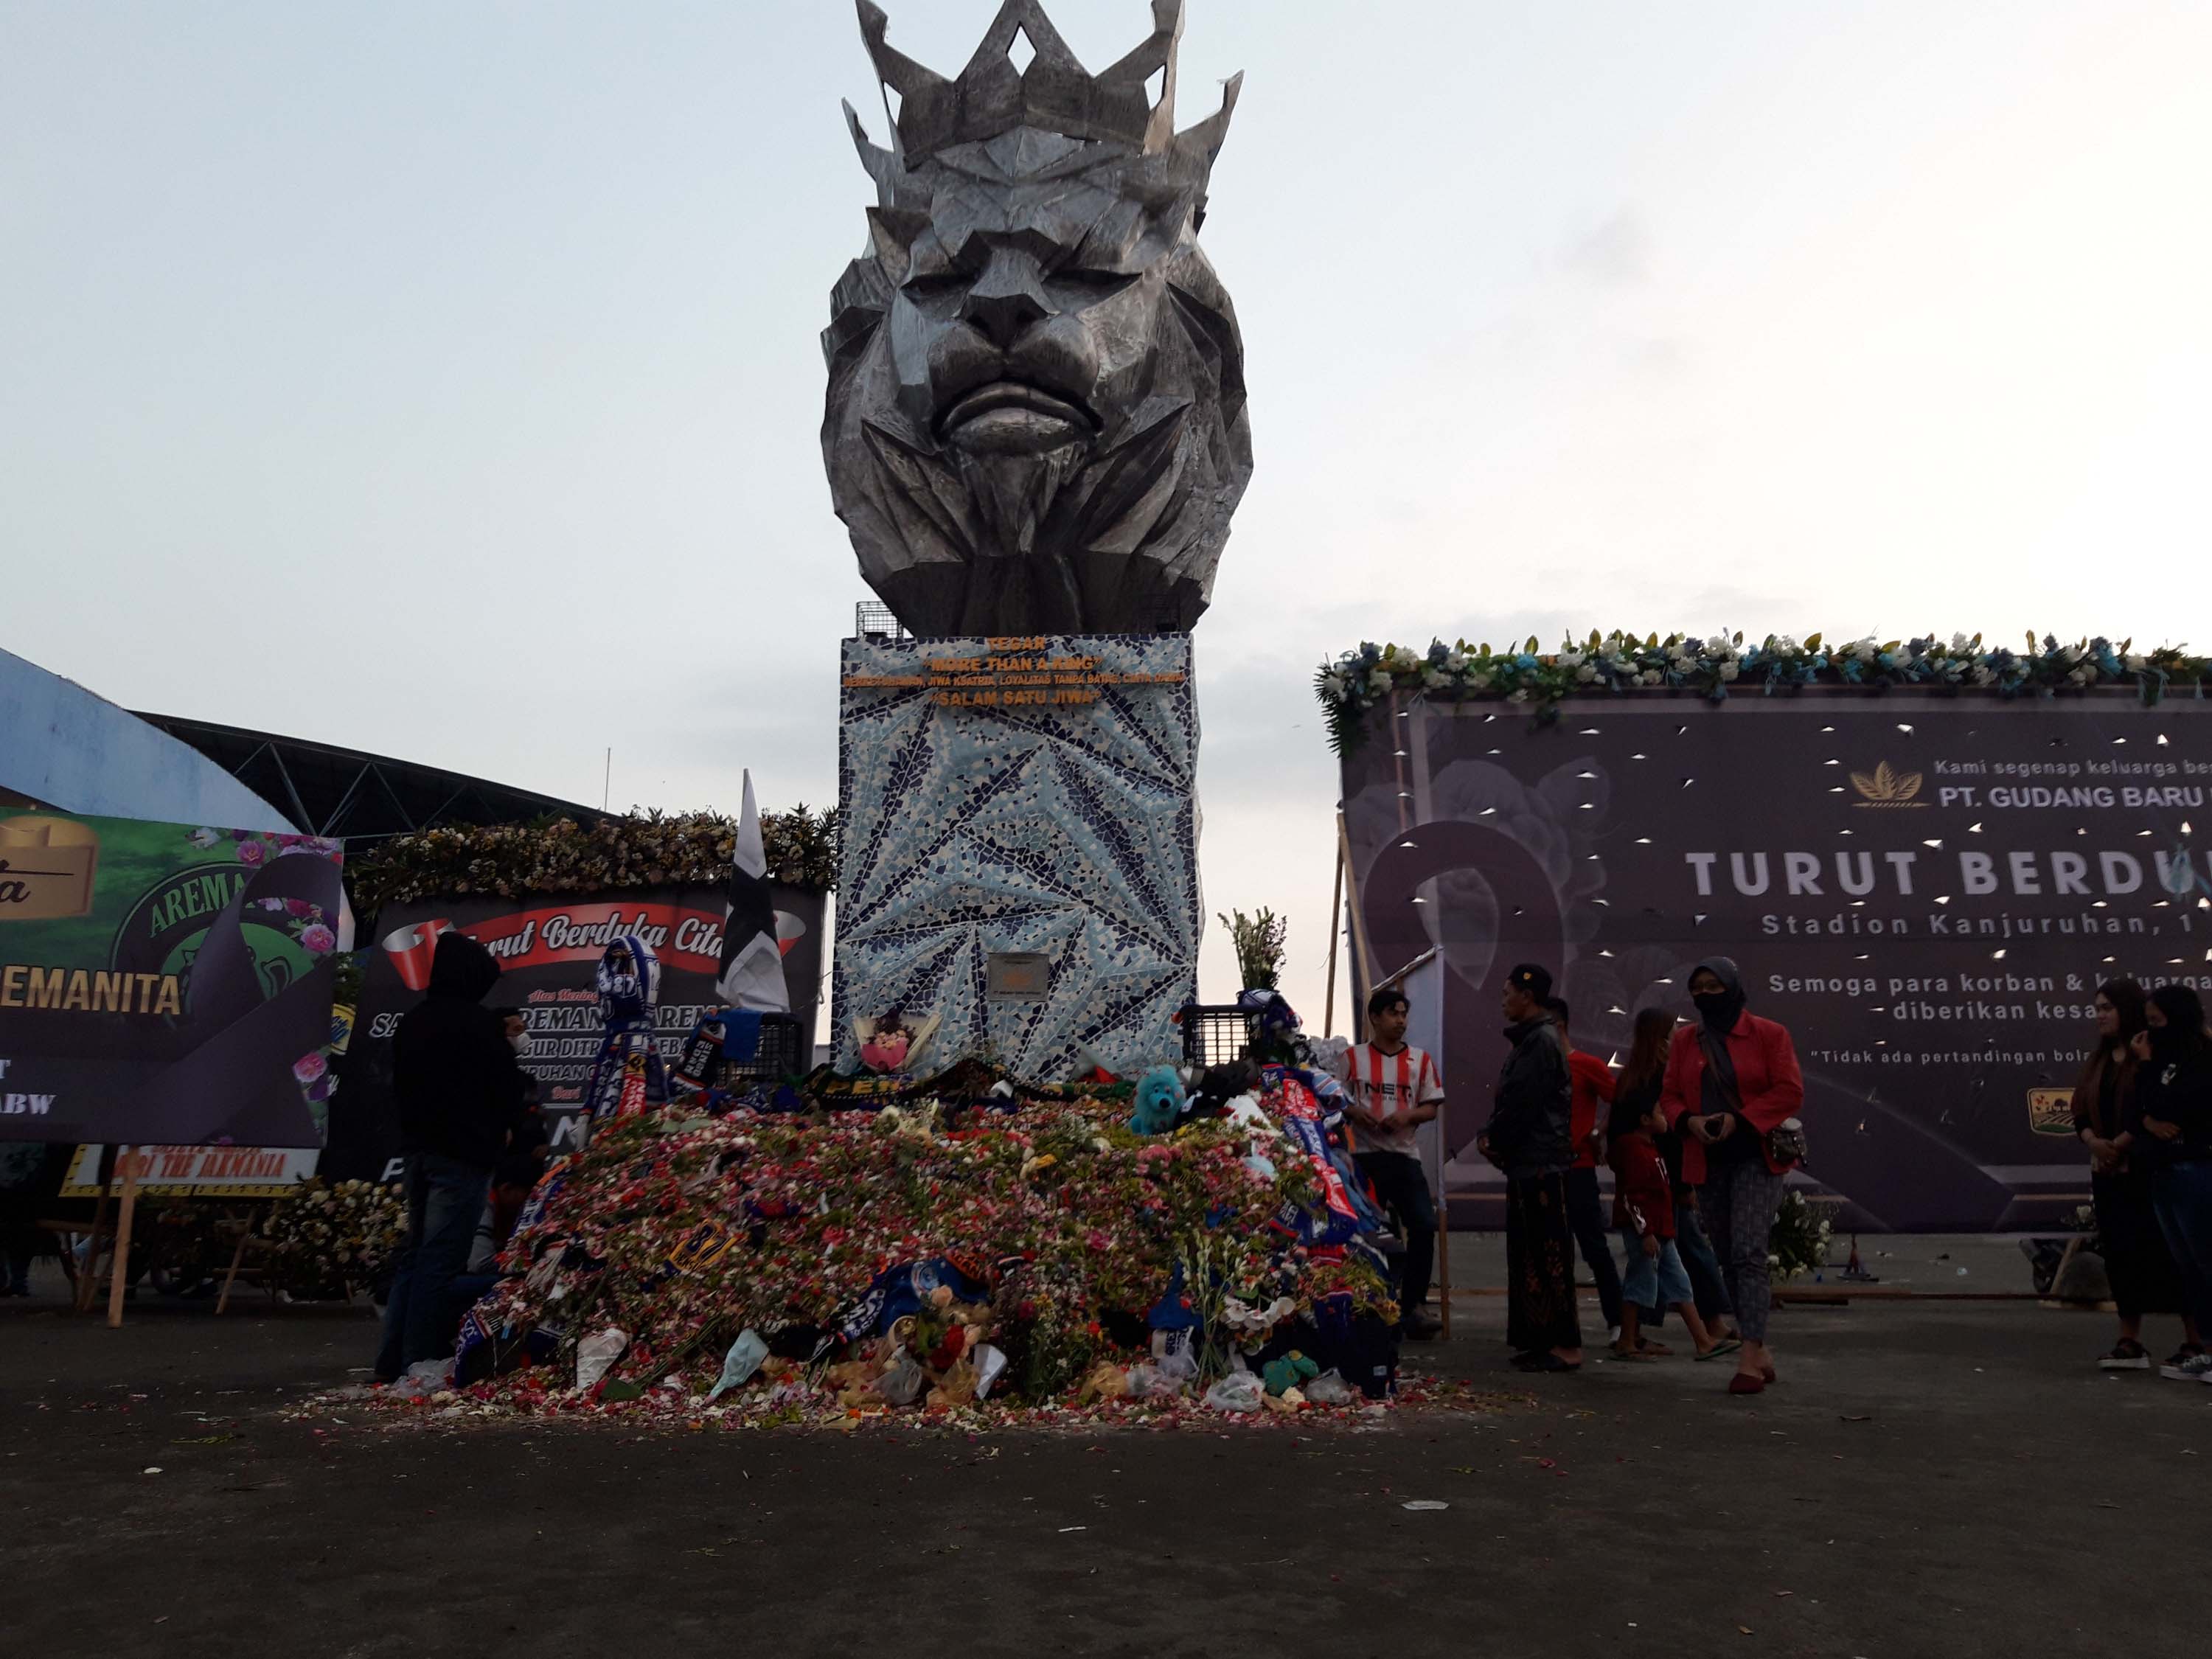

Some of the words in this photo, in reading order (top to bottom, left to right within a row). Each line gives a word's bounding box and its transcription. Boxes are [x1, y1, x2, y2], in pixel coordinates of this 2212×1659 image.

[987, 636, 1046, 650] TEGAR
[987, 656, 1033, 672] THAN
[1037, 658, 1048, 671] A
[931, 675, 950, 687] JIWA
[1002, 690, 1047, 705] SATU
[1934, 759, 1986, 774] Kami
[1993, 761, 2081, 777] segenap
[2086, 759, 2177, 777] keluarga
[1938, 786, 1983, 808] PT.
[1989, 786, 2115, 808] GUDANG
[2121, 785, 2204, 808] BARU
[1685, 852, 1917, 897] TURUT
[1958, 850, 2212, 895] BERDU
[540, 911, 668, 950] Berduka
[1761, 913, 1909, 935] Stadion
[1929, 912, 2160, 939] Kanjuruhan,
[2179, 914, 2192, 933] 1
[1769, 974, 1877, 996] Semoga
[1889, 977, 1948, 996] para
[1960, 973, 2053, 992] korban
[2065, 973, 2084, 992] &
[1893, 1001, 2025, 1020] diberikan
[1810, 1050, 1873, 1062] "Tidak
[1881, 1050, 1913, 1062] ada
[1921, 1050, 2046, 1065] pertandingan
